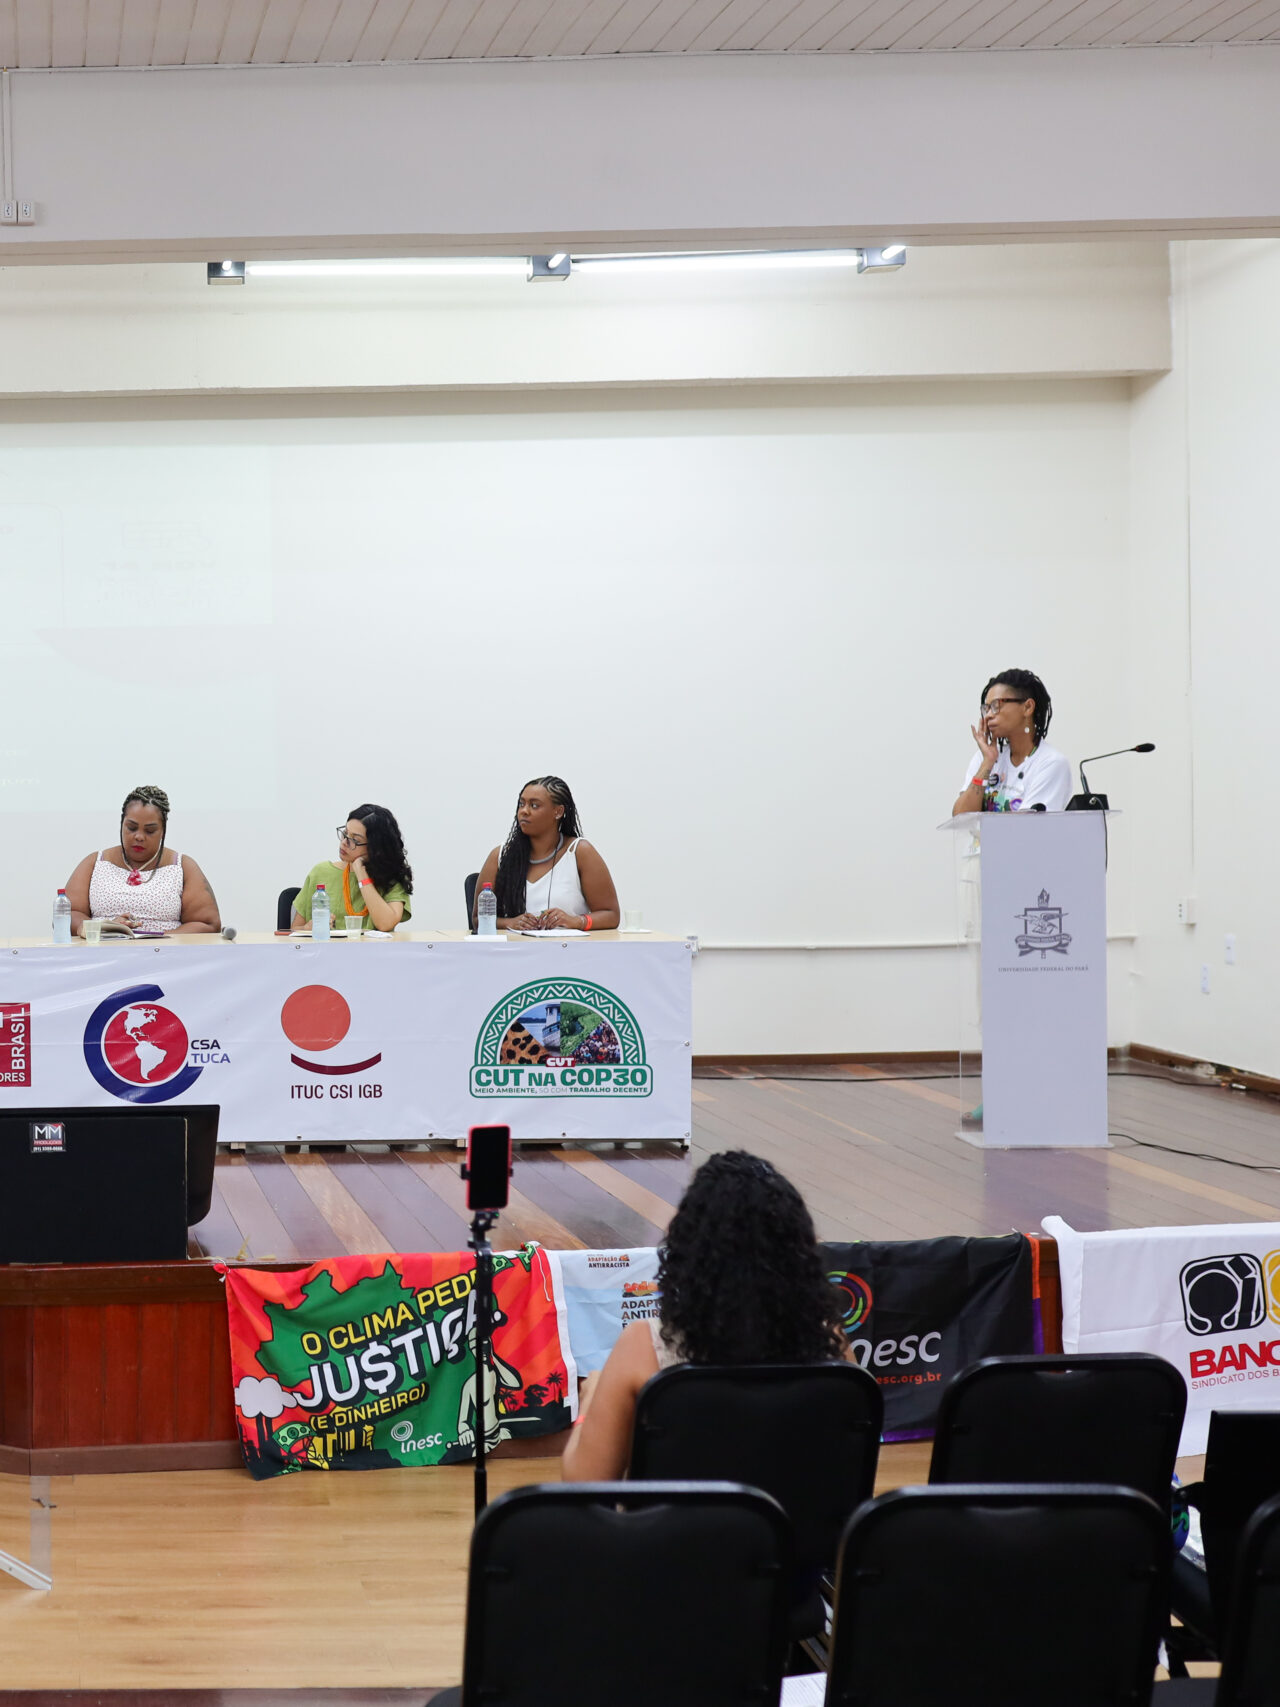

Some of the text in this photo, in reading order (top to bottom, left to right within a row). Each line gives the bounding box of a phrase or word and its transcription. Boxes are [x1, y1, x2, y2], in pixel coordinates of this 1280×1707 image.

[11, 1007, 25, 1070] BRASIL
[191, 1039, 221, 1050] CSA
[191, 1053, 231, 1064] TUCA
[547, 1057, 575, 1067] CUT
[475, 1068, 647, 1087] CUT NA COP30
[291, 1084, 383, 1099] ITUC CSI IGB
[34, 1125, 62, 1140] MM
[301, 1332, 322, 1355] O
[327, 1302, 415, 1350] CLIMA
[1191, 1373, 1245, 1390] SINDICATO
[1248, 1369, 1269, 1380] DOS
[310, 1383, 426, 1431] (E DINHEIRO)
[401, 1432, 443, 1454] inesc
